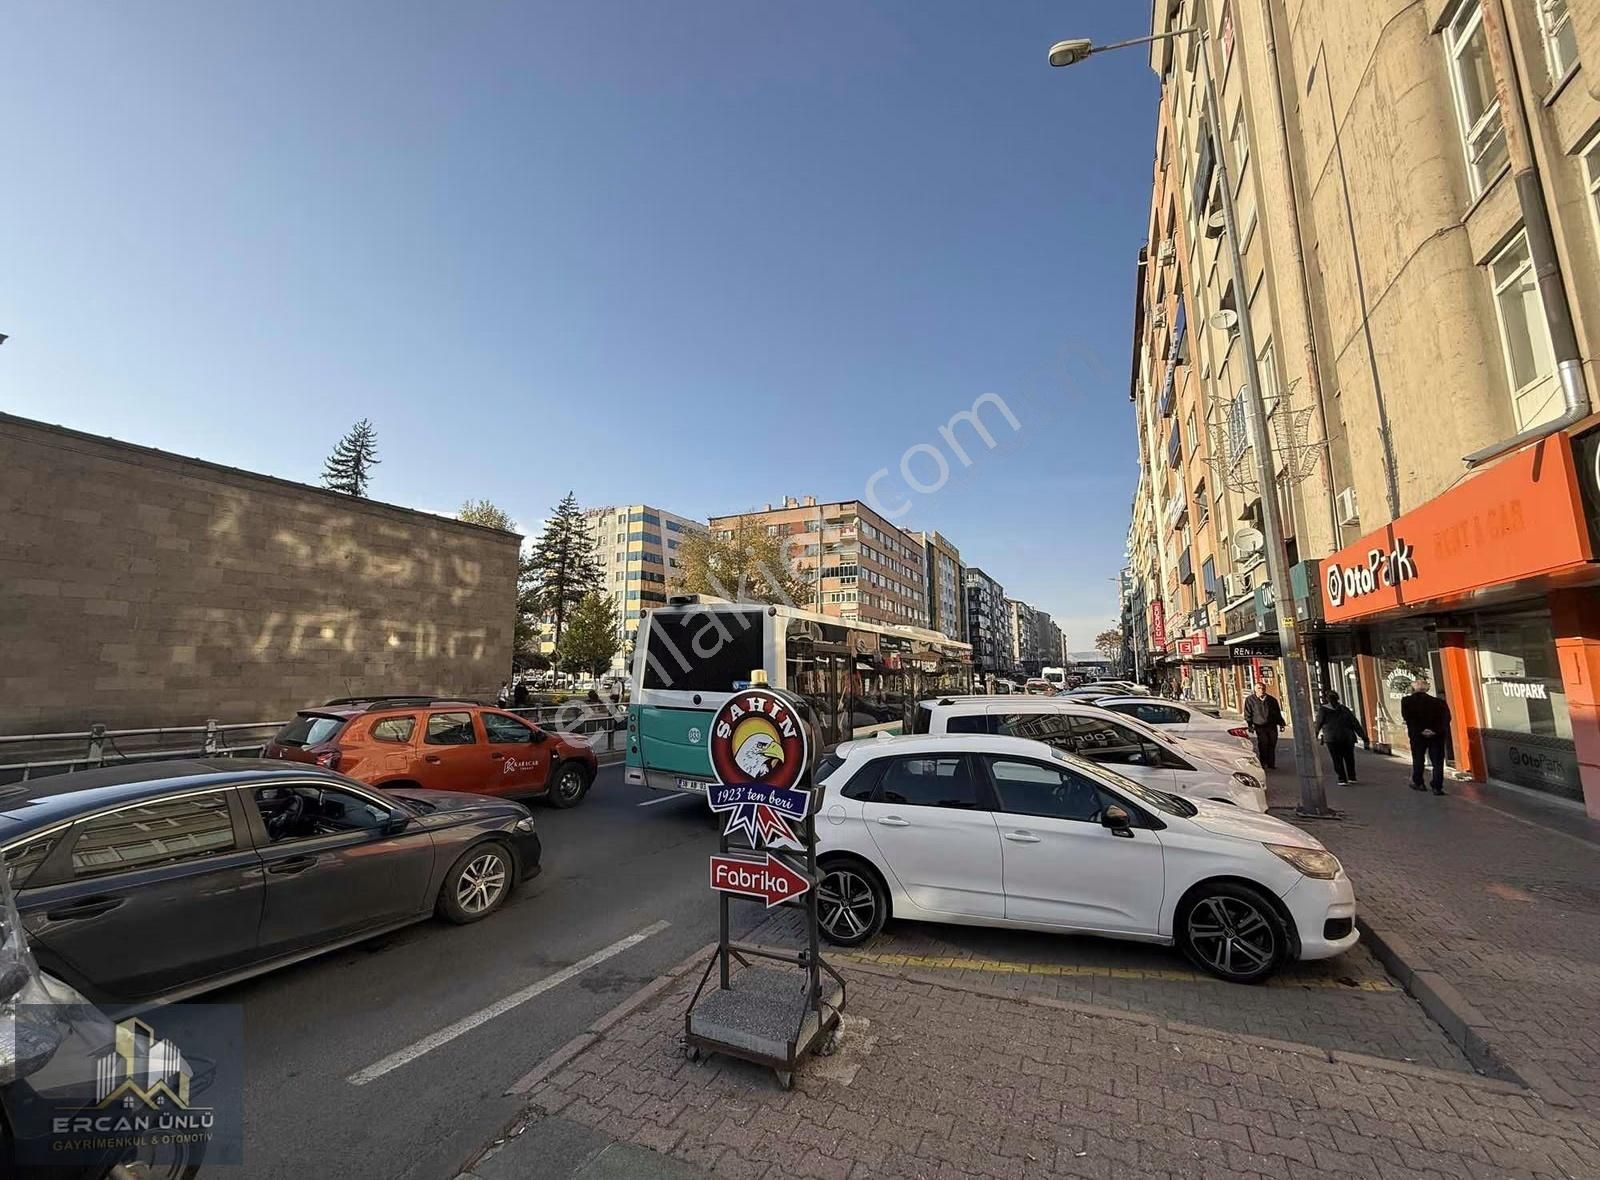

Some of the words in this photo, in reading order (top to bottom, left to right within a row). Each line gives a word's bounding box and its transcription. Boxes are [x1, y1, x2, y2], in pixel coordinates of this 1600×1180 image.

[1233, 647, 1254, 656] RENT
[1502, 682, 1547, 700] OTOPARK
[747, 788, 766, 803] ten
[769, 790, 794, 810] beri
[716, 865, 788, 894] Fabrika
